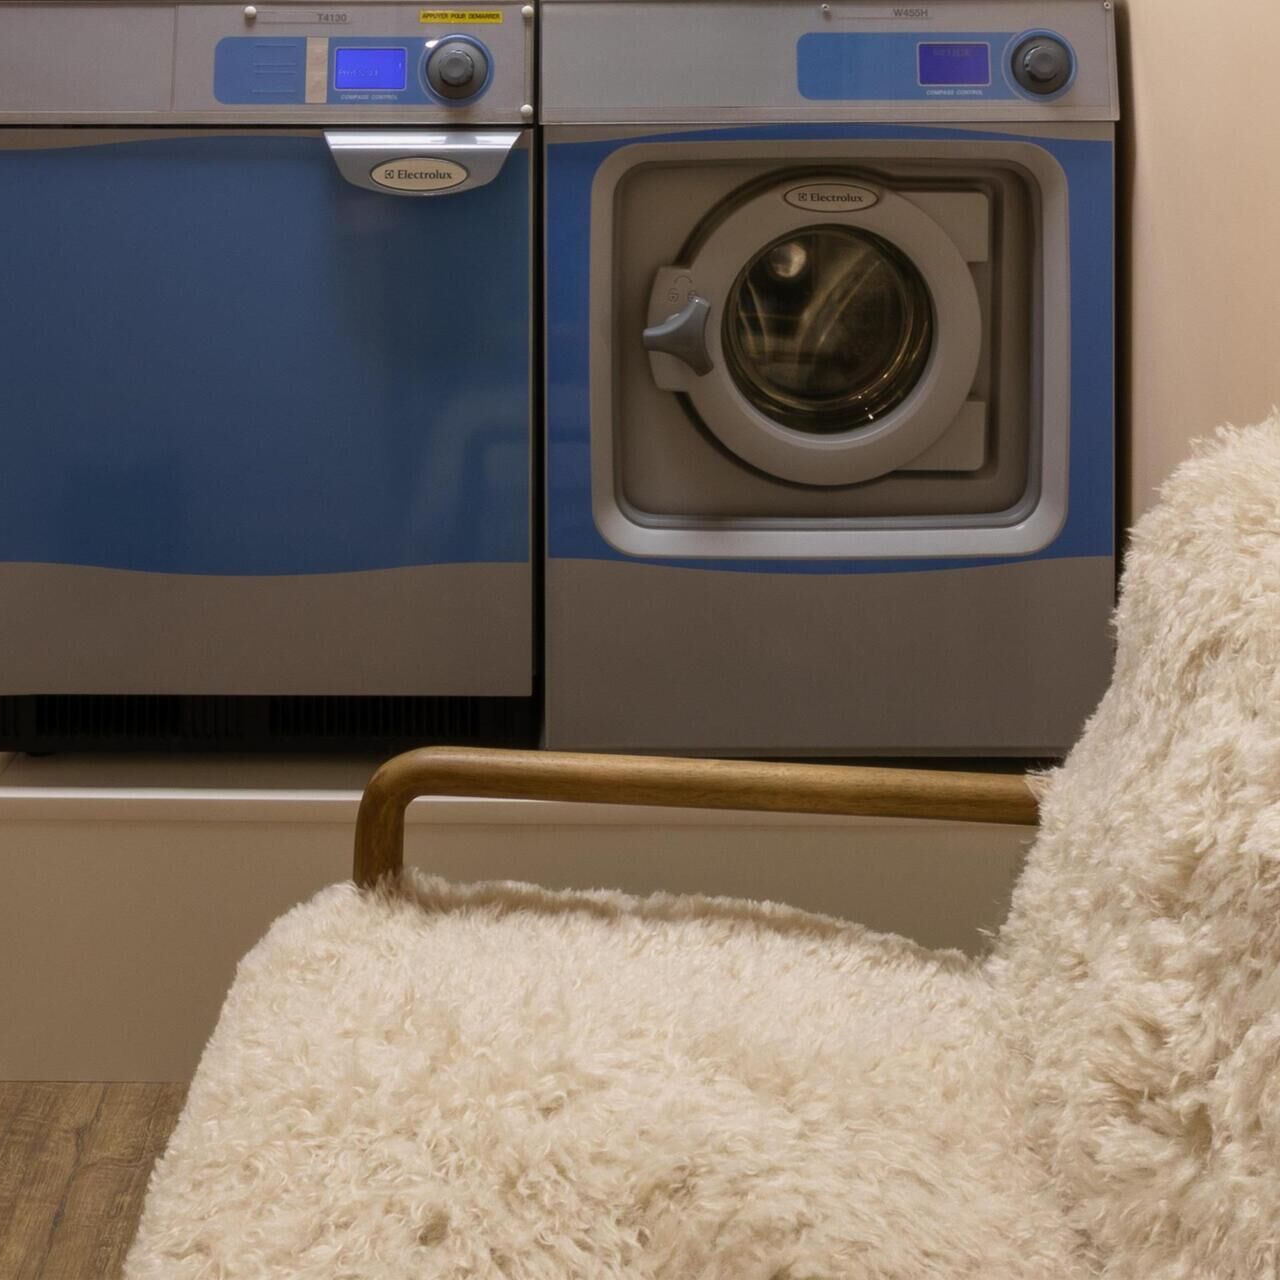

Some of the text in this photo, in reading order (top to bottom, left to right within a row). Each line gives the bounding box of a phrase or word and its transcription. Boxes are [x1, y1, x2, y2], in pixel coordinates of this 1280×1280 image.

[450, 11, 467, 20] POUR
[397, 169, 452, 179] Electrolux
[810, 192, 864, 202] Electrolux
